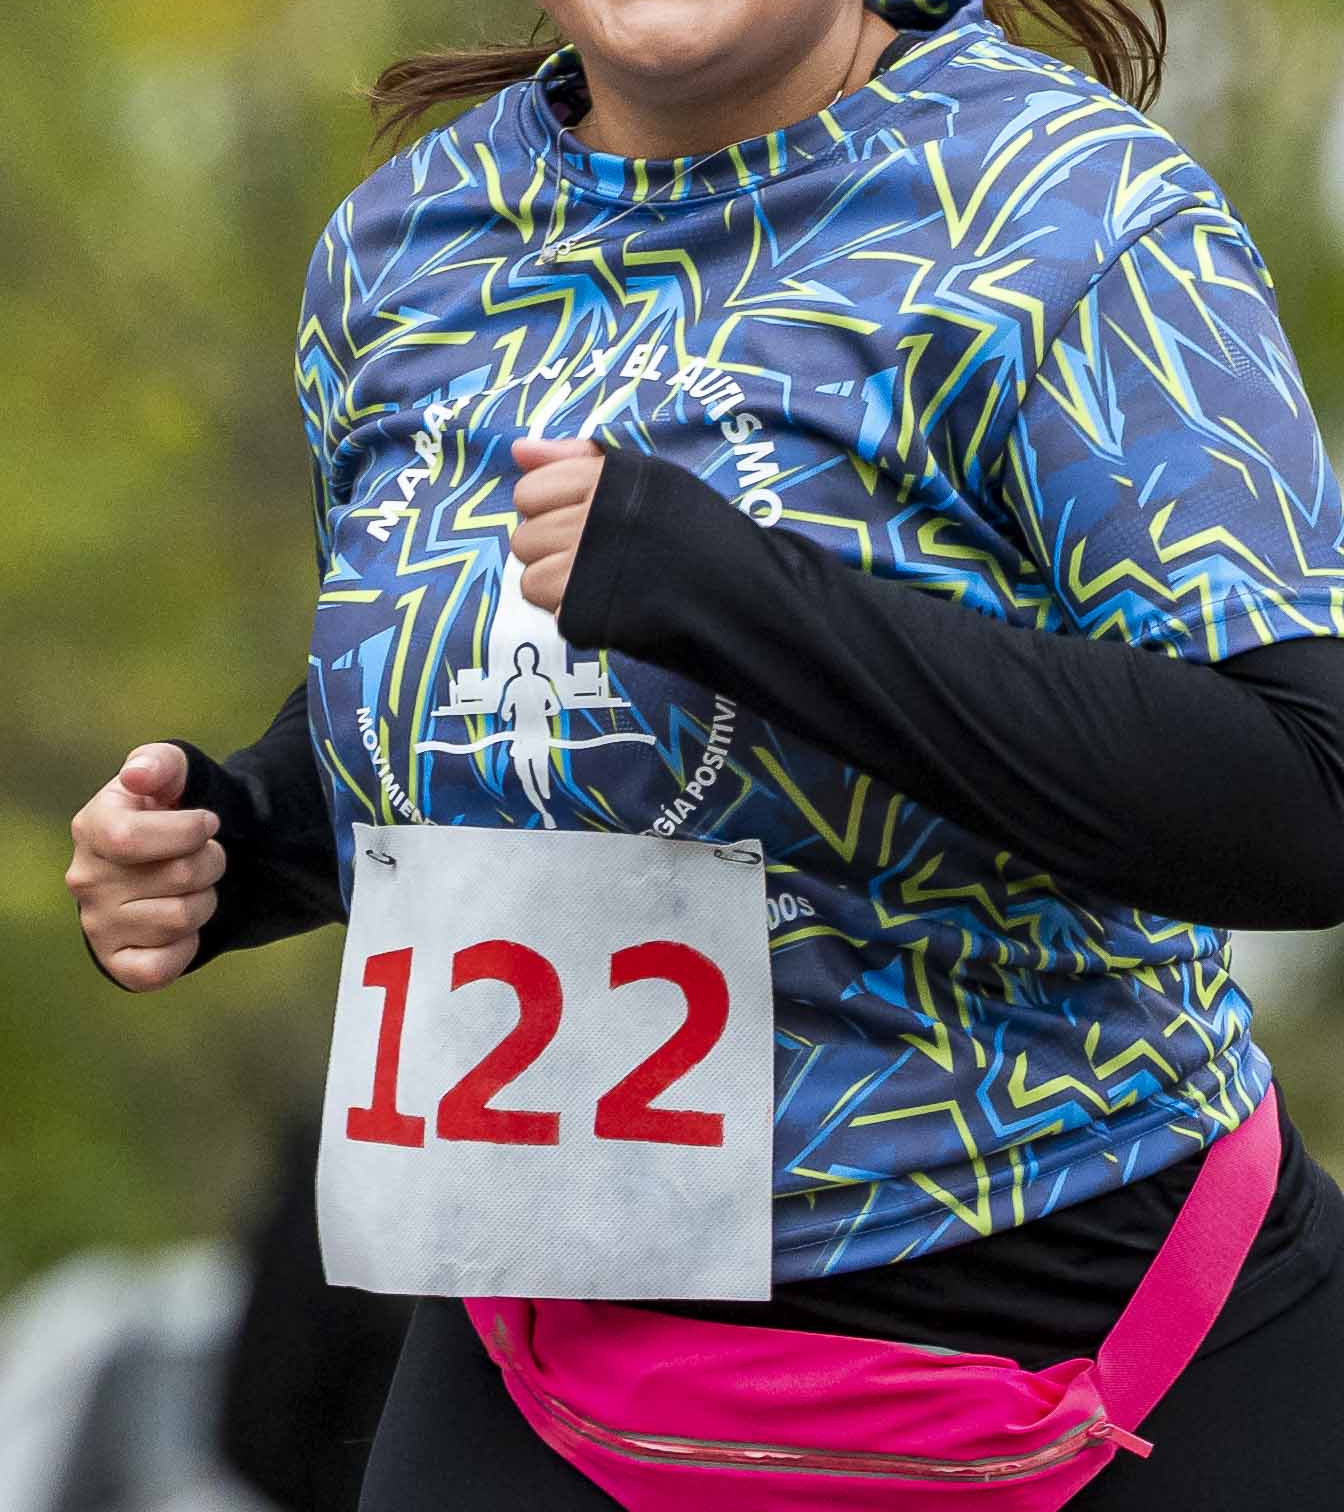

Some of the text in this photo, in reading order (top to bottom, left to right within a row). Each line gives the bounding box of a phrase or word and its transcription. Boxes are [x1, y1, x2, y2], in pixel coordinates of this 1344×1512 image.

[574, 346, 618, 378] X
[665, 356, 783, 529] AUTISMO
[347, 940, 729, 1147] 122
